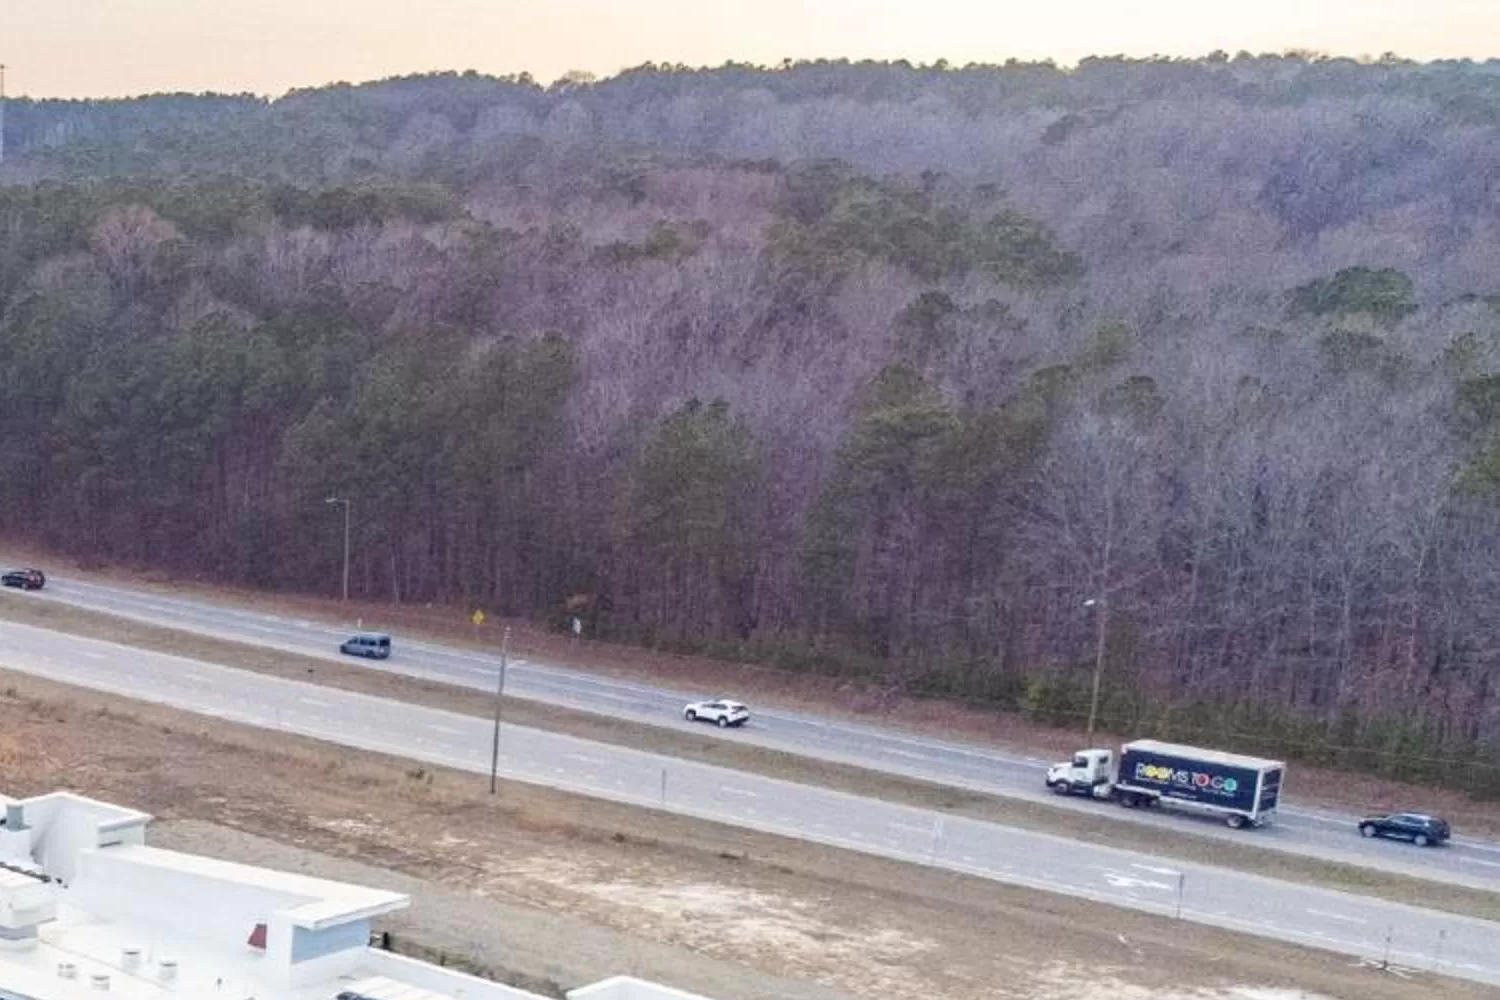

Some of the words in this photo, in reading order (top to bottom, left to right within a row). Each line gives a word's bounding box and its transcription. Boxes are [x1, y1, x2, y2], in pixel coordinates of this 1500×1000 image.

[1135, 763, 1189, 784] ROOMS
[1191, 771, 1210, 787] TO
[1211, 776, 1237, 792] GO
